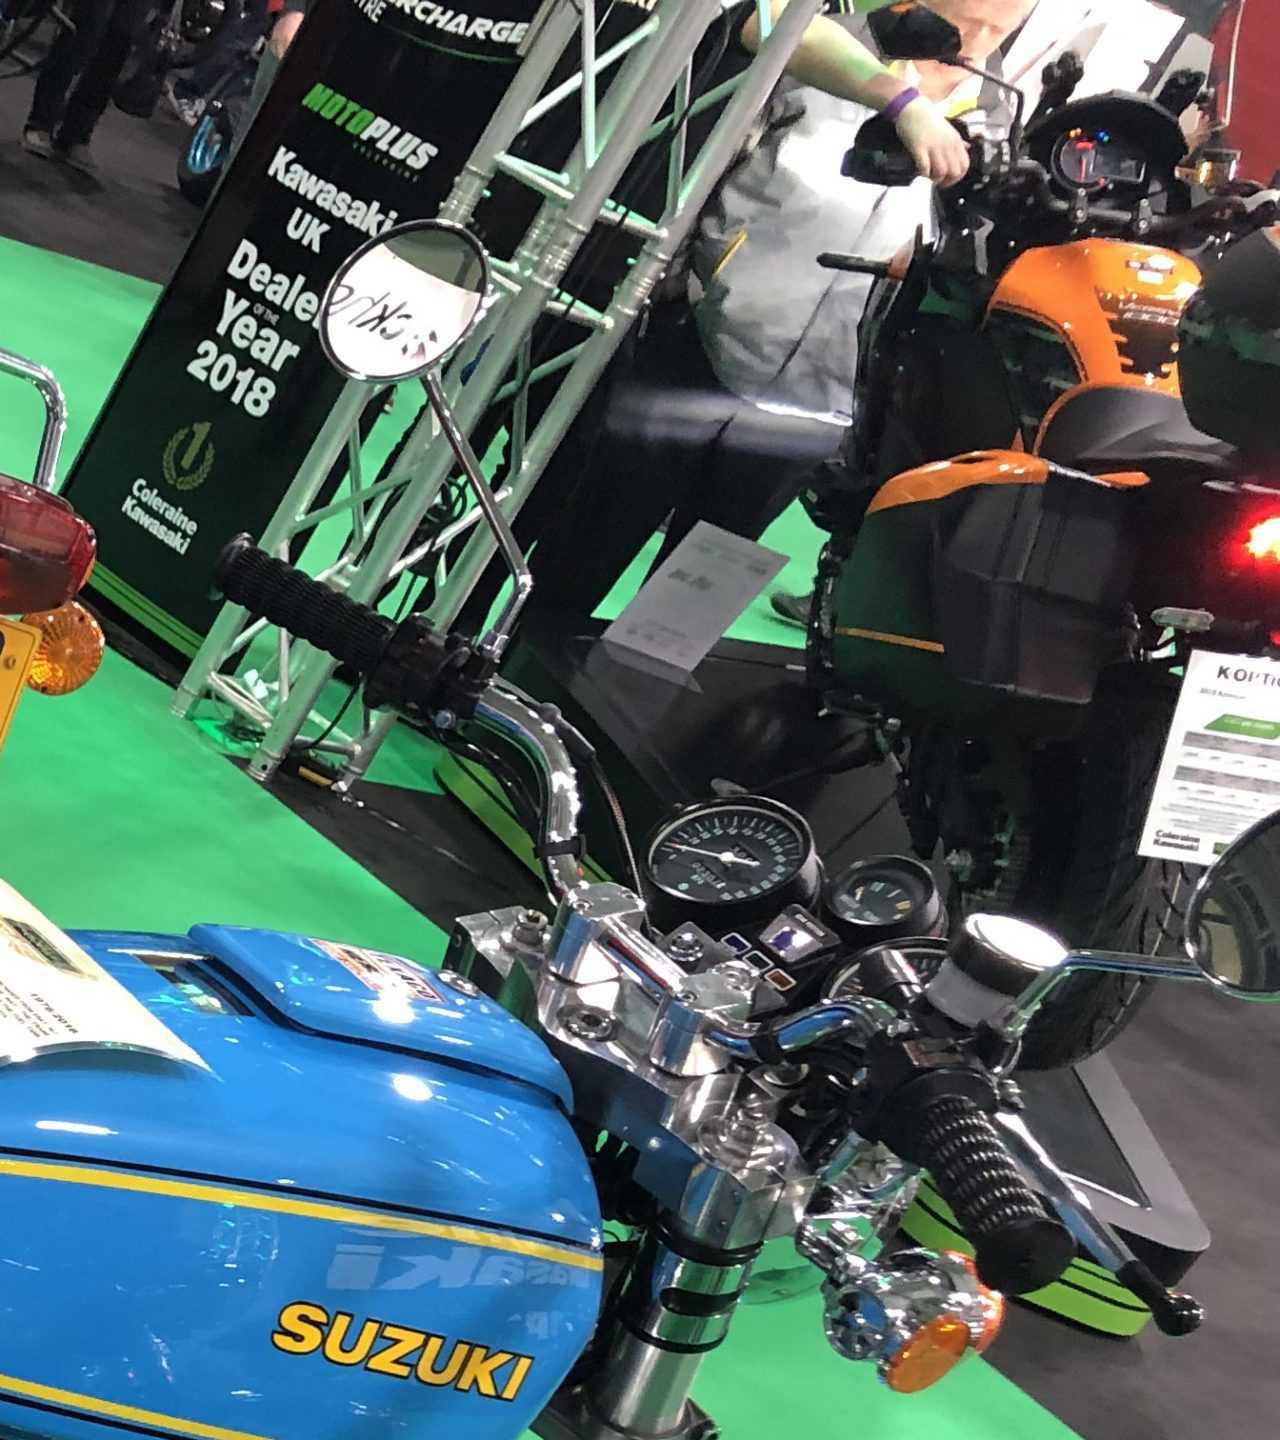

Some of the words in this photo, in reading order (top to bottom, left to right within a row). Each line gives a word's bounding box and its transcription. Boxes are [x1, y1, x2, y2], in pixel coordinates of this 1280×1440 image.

[301, 83, 439, 171] MOTOPLUS
[267, 145, 399, 236] Kawasaki
[286, 206, 331, 254] UK
[214, 288, 300, 372] Year
[186, 339, 277, 419] 2018
[121, 499, 191, 556] Kawasaki
[131, 477, 198, 536] Coleraine
[1152, 837, 1200, 853] Kawasaki
[271, 1299, 536, 1404] SUZUKI
